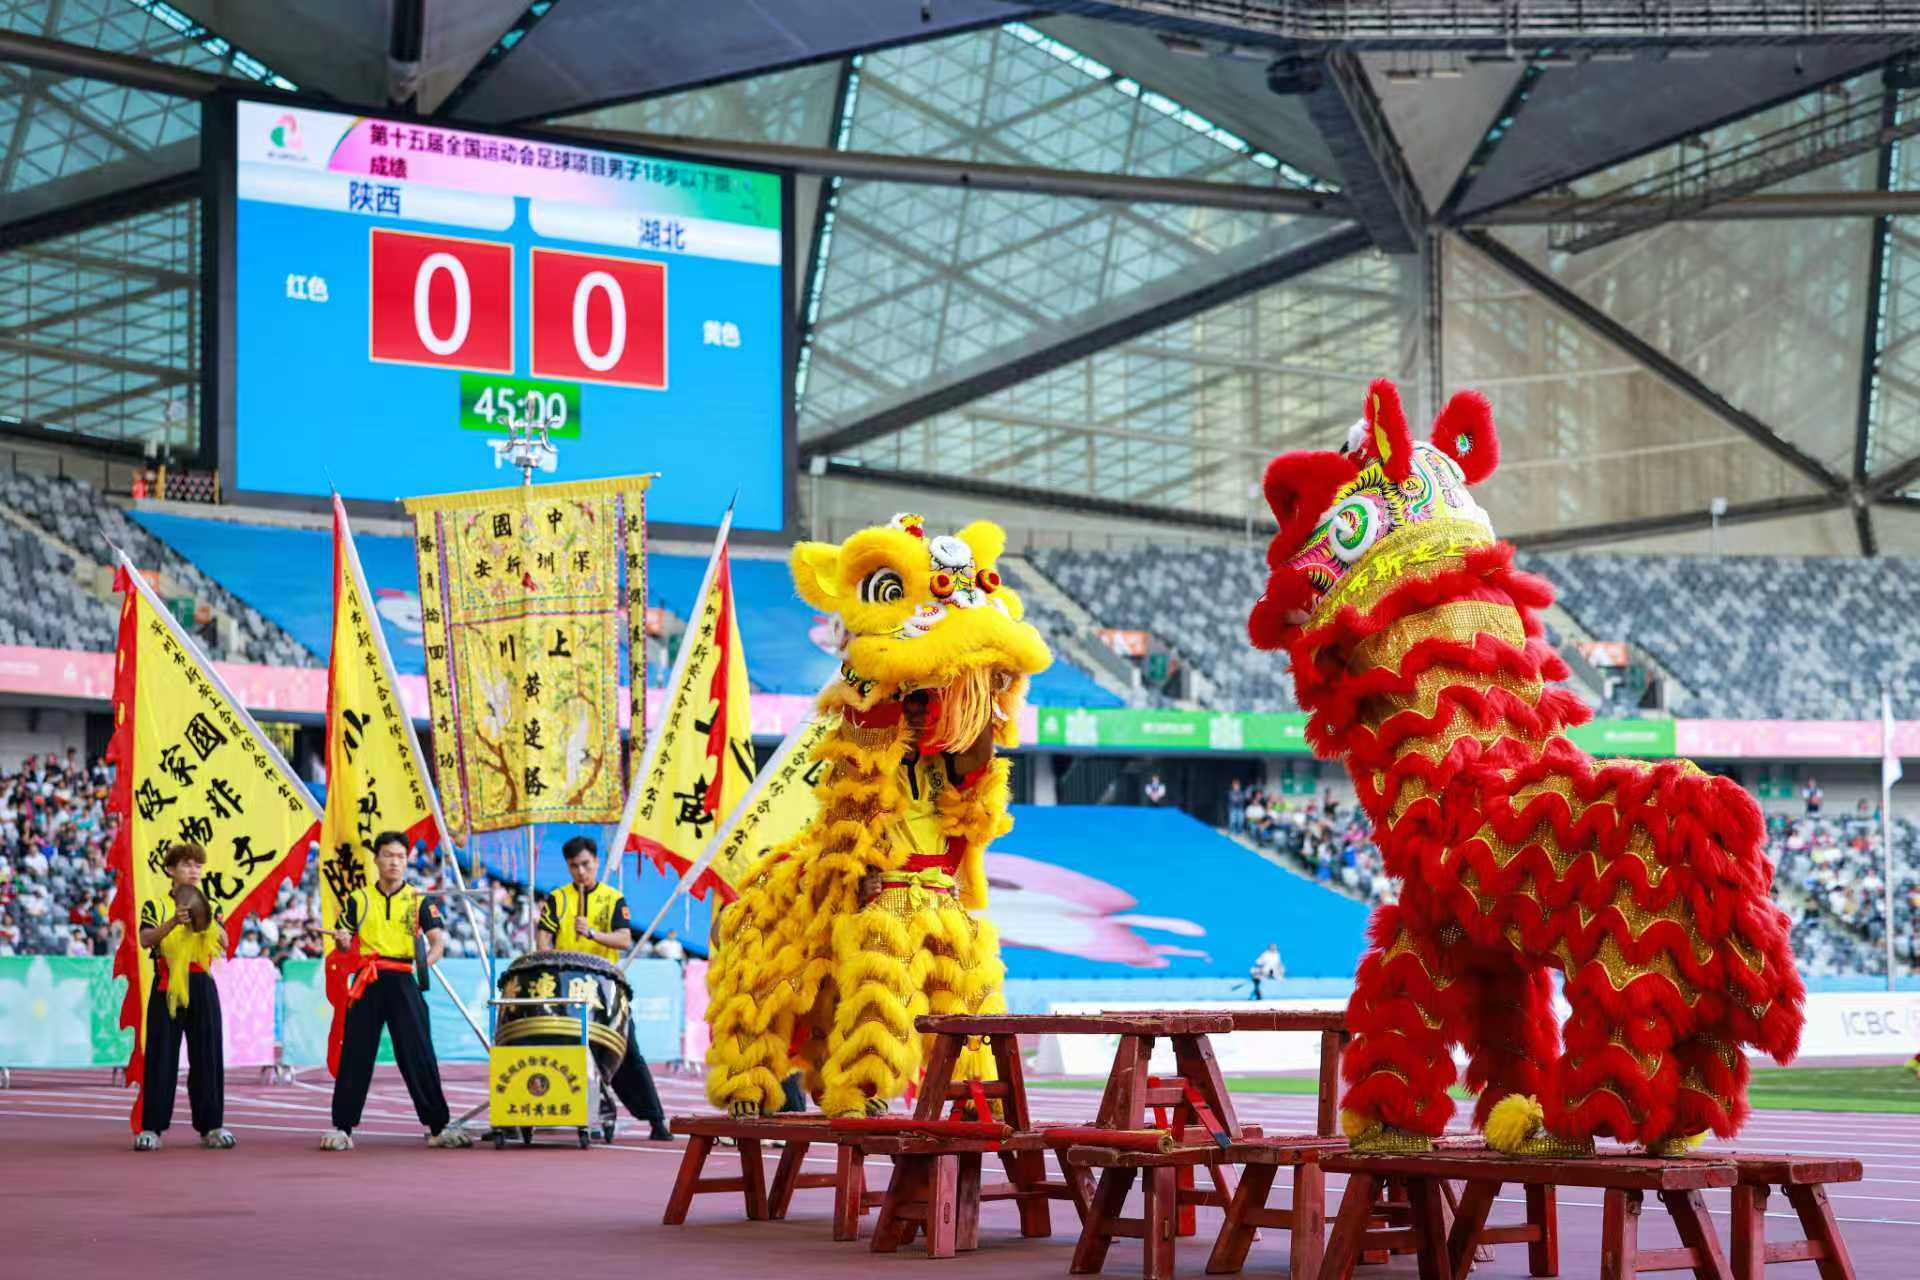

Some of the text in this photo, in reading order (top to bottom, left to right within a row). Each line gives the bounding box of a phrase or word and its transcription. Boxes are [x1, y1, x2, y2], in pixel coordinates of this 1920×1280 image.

[370, 155, 408, 180] 成绩
[349, 181, 401, 215] 陕西
[639, 216, 687, 250] 湖北
[285, 273, 329, 303] 红色
[413, 252, 472, 356] 0
[572, 271, 627, 372] 0
[702, 318, 742, 349] 黄色
[473, 386, 568, 430] 45:00
[1840, 1010, 1901, 1037] ICBC
